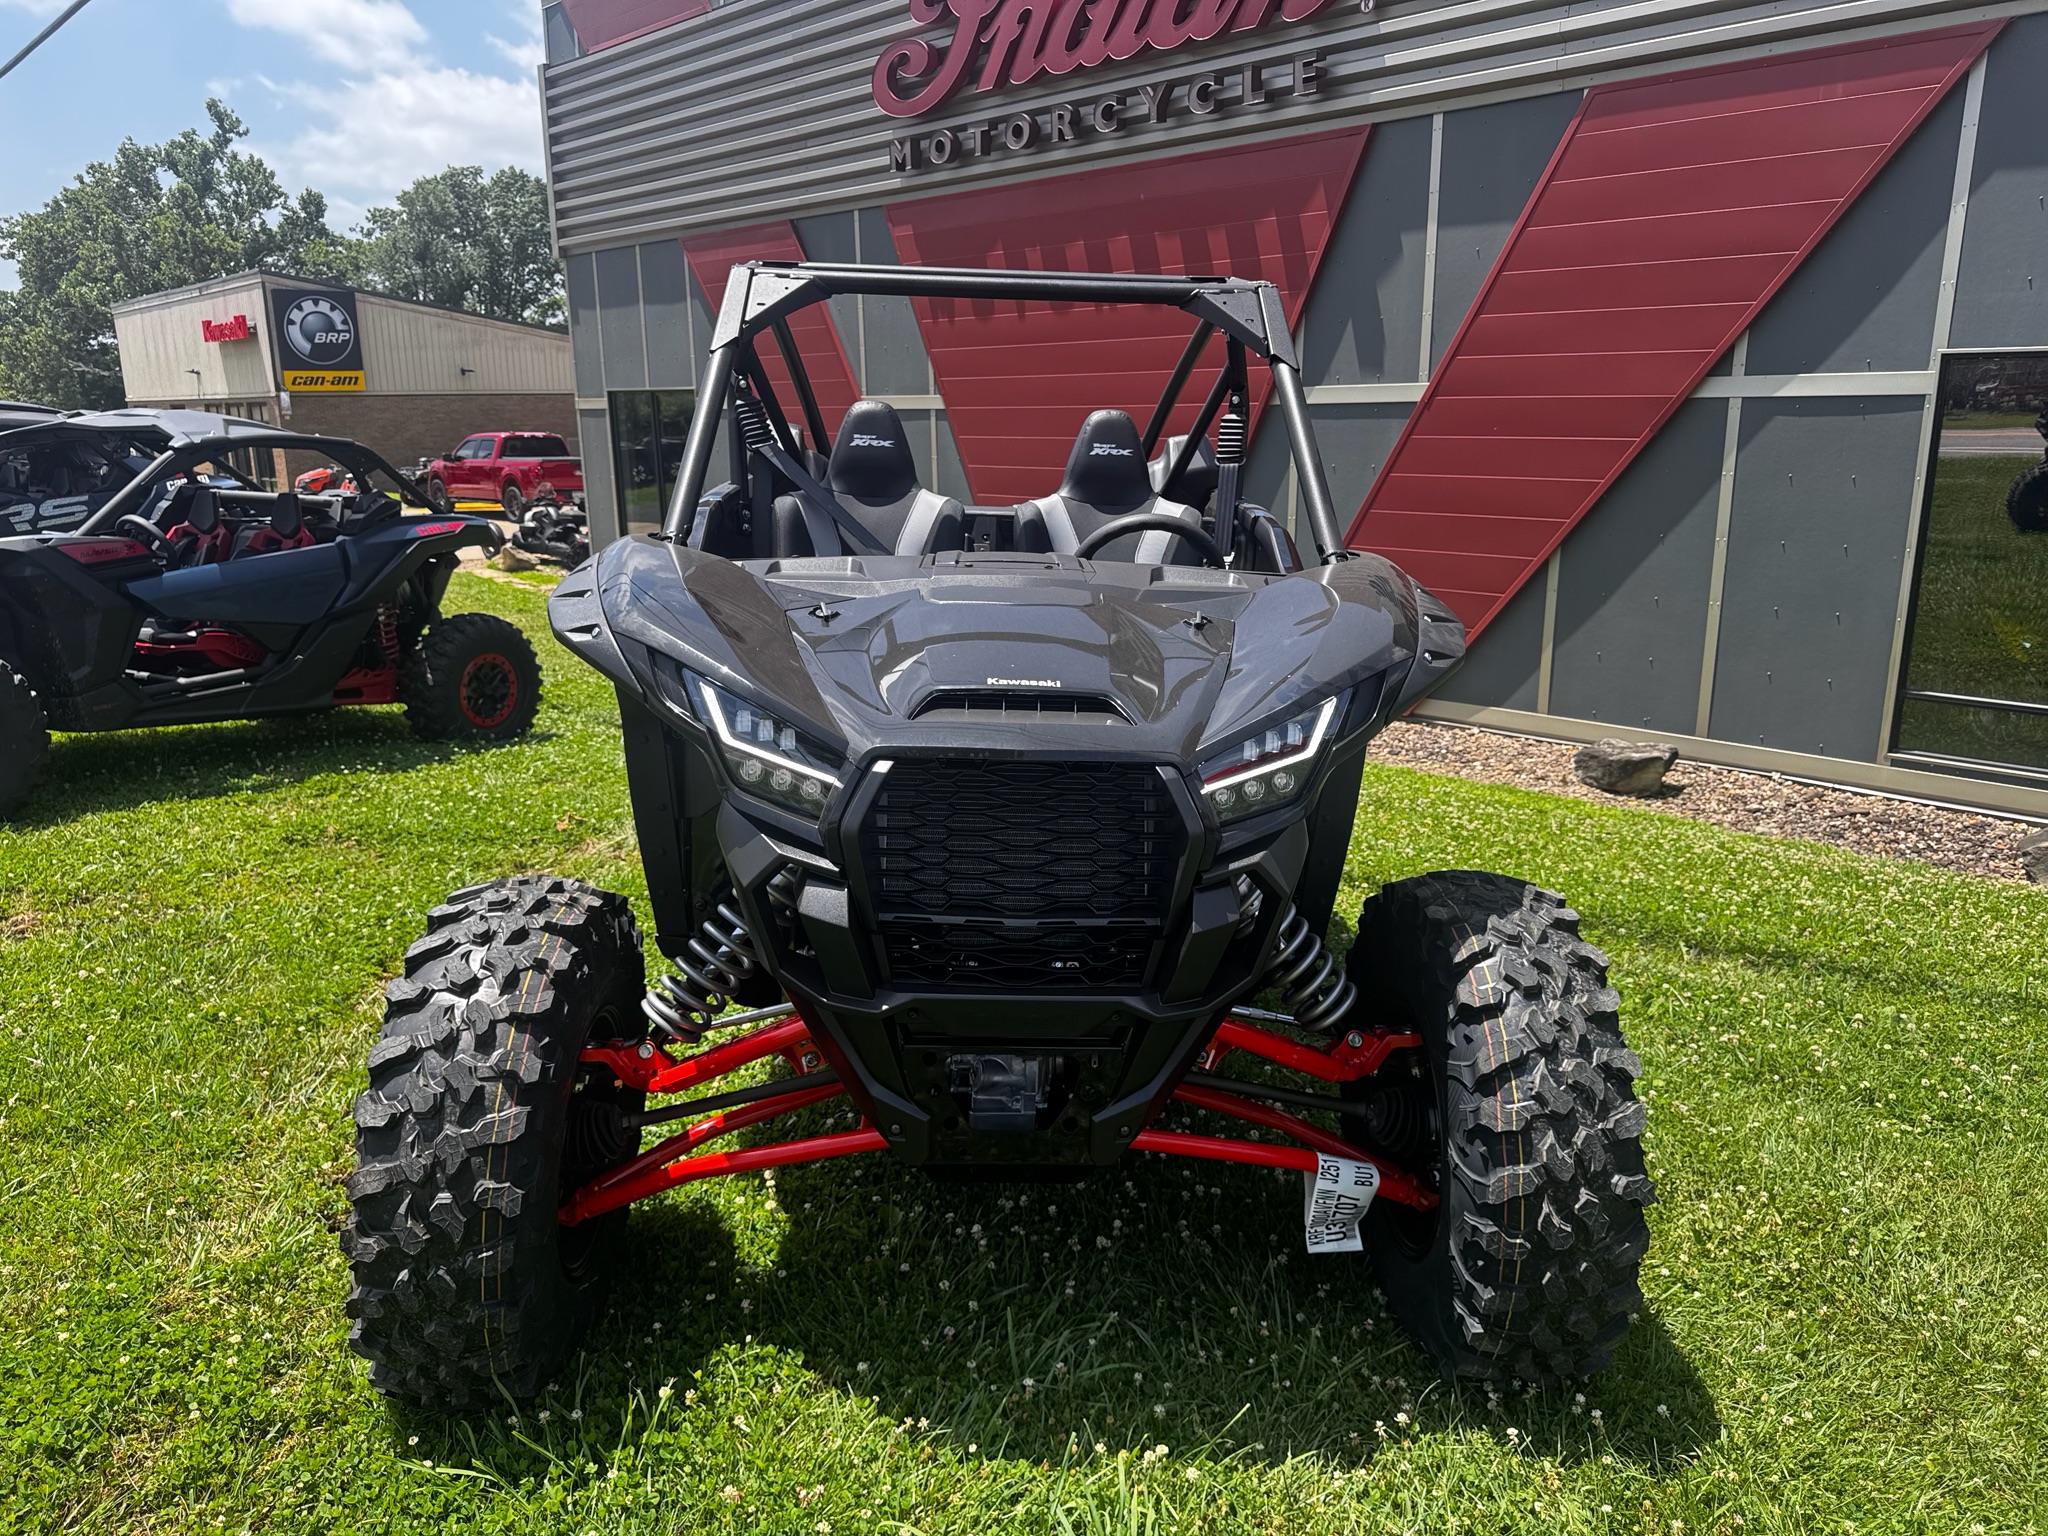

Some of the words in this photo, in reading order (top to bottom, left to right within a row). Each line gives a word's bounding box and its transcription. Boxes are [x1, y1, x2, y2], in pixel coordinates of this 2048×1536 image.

[889, 50, 1327, 172] MOTORCYCLE
[314, 332, 350, 344] BRP
[849, 438, 895, 448] KRX
[1089, 447, 1134, 457] KRX
[80, 543, 137, 559] MAVERICK
[986, 677, 1061, 688] Kawasaki
[1319, 1158, 1341, 1185] J251
[1353, 1164, 1374, 1187] BU1
